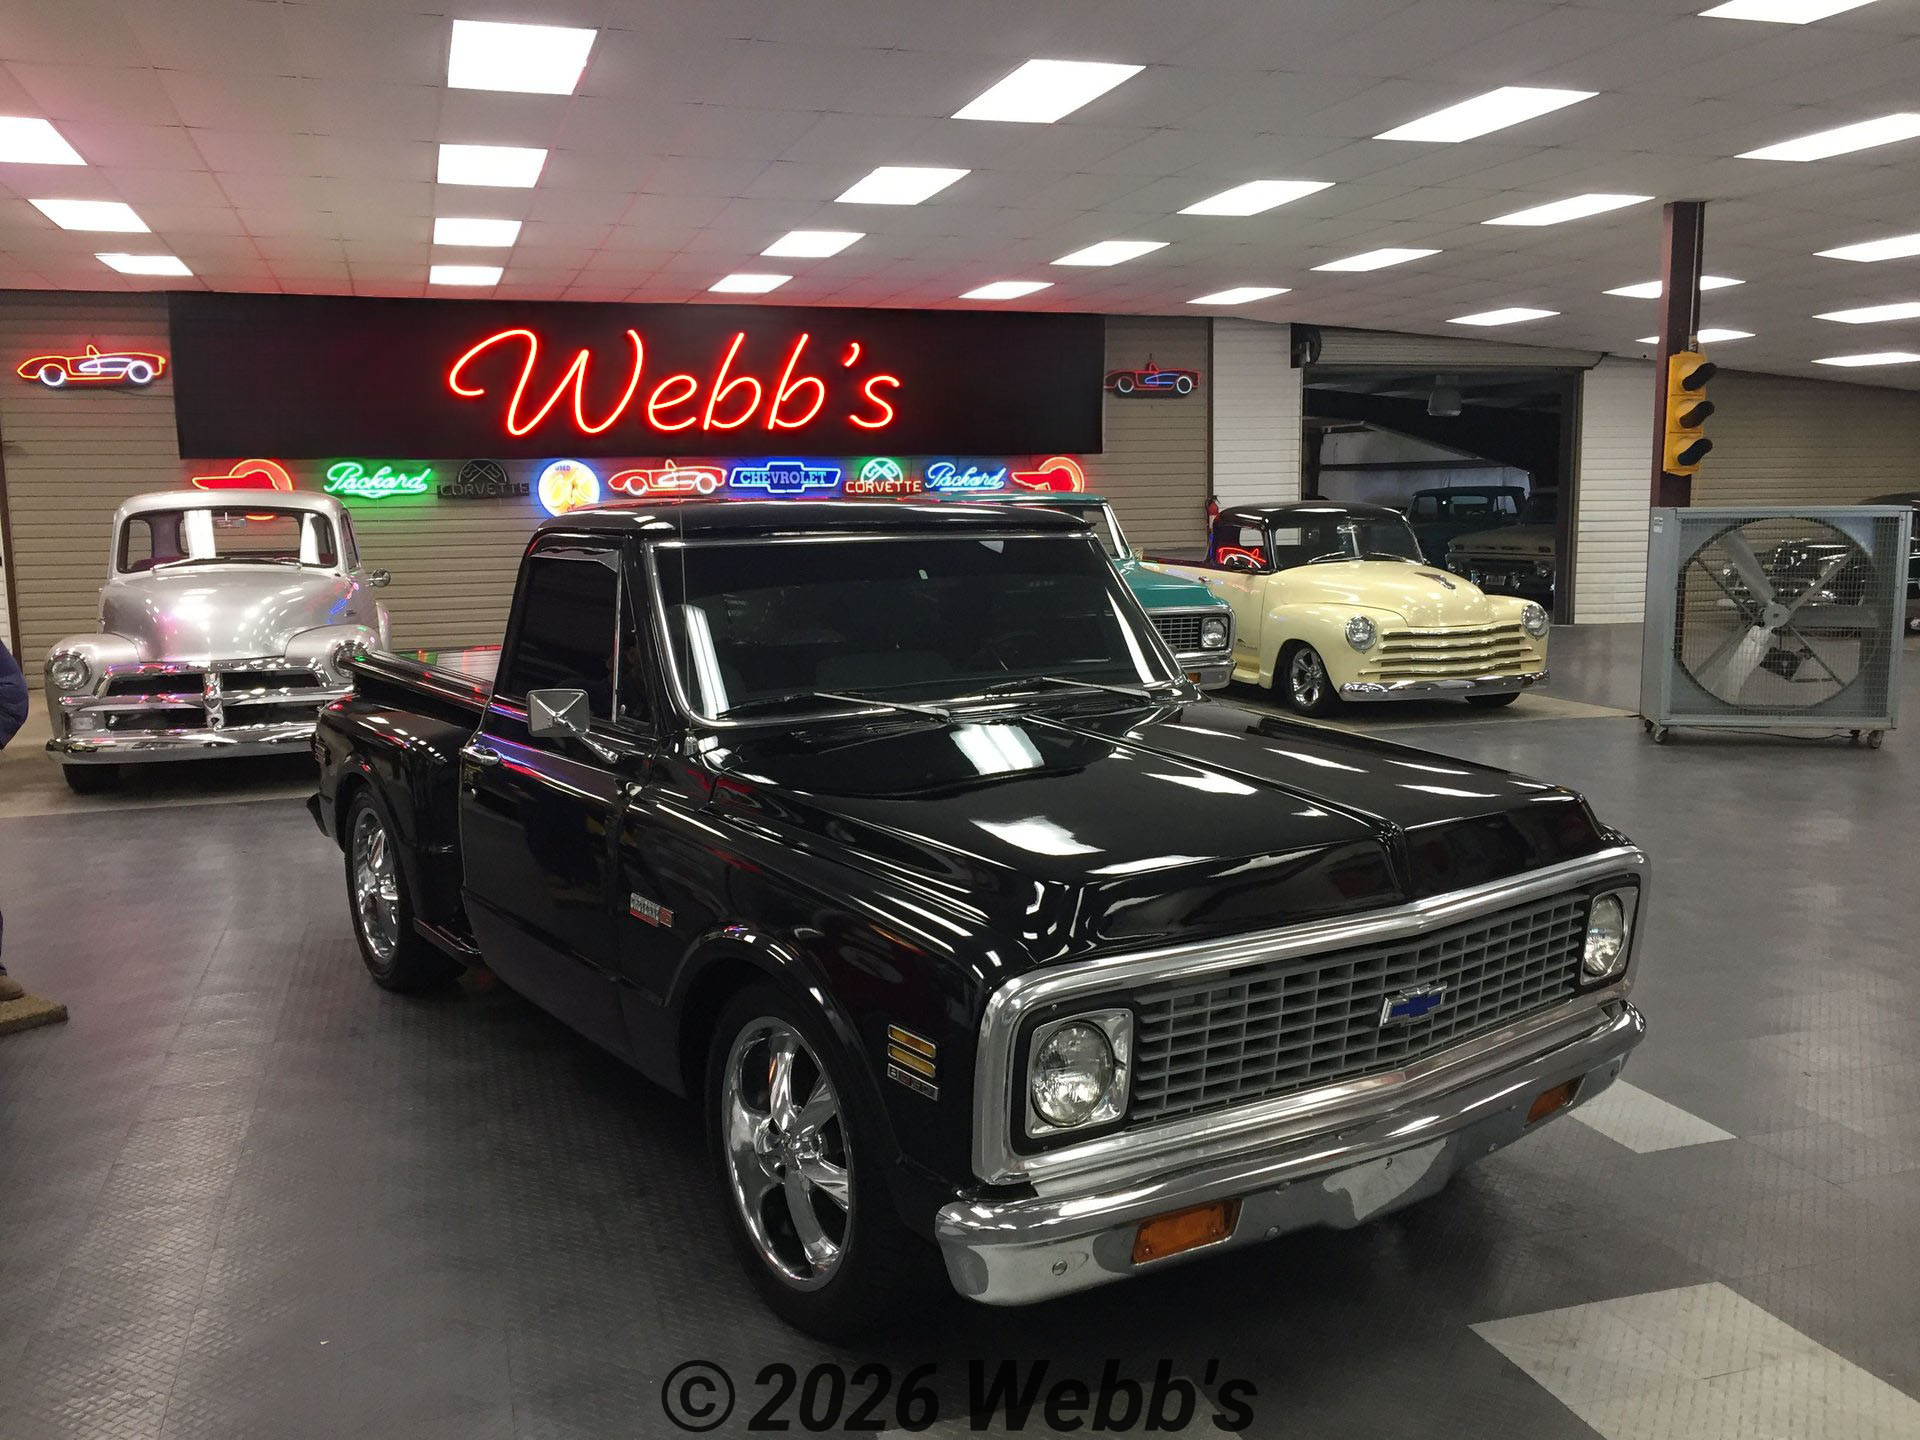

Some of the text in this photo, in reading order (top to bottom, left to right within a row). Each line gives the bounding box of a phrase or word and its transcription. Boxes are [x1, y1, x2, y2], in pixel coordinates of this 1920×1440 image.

[448, 328, 901, 436] Webb's
[323, 461, 432, 495] Packard
[741, 470, 828, 485] CHEVROLET
[925, 462, 1007, 489] Packard
[440, 482, 530, 496] CORVETTE
[845, 480, 922, 494] CORVETTE
